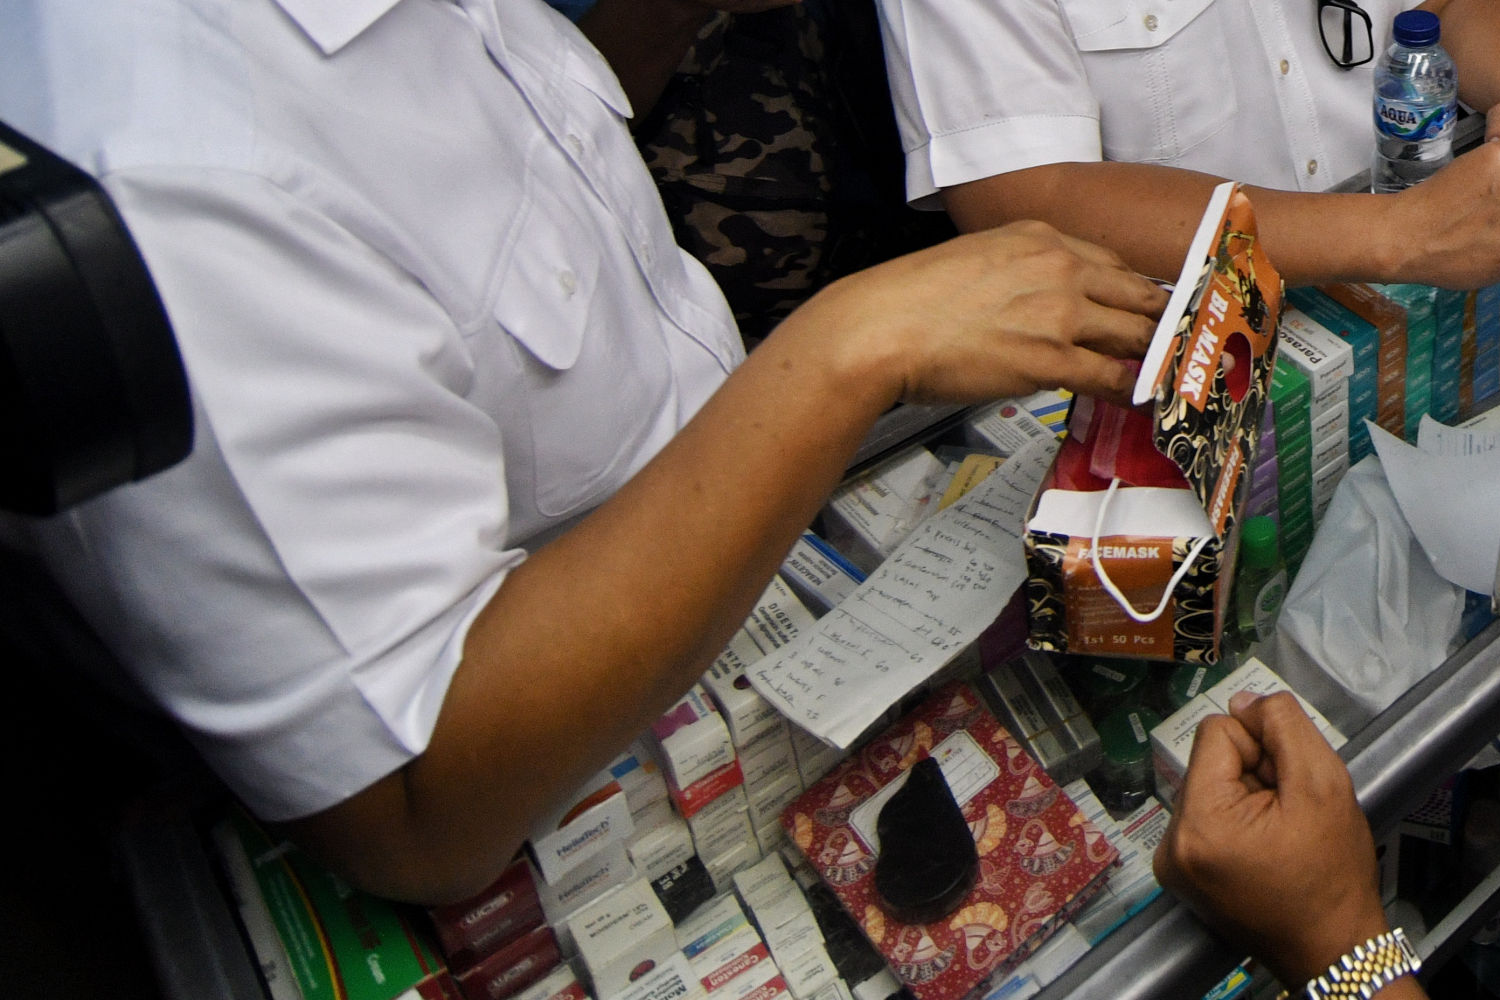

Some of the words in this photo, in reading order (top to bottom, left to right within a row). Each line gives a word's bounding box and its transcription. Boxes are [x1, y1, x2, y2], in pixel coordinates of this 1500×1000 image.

[1380, 103, 1417, 126] AQUA
[1112, 634, 1127, 644] 50
[1133, 635, 1155, 645] Pcs
[709, 954, 760, 987] Canesten
